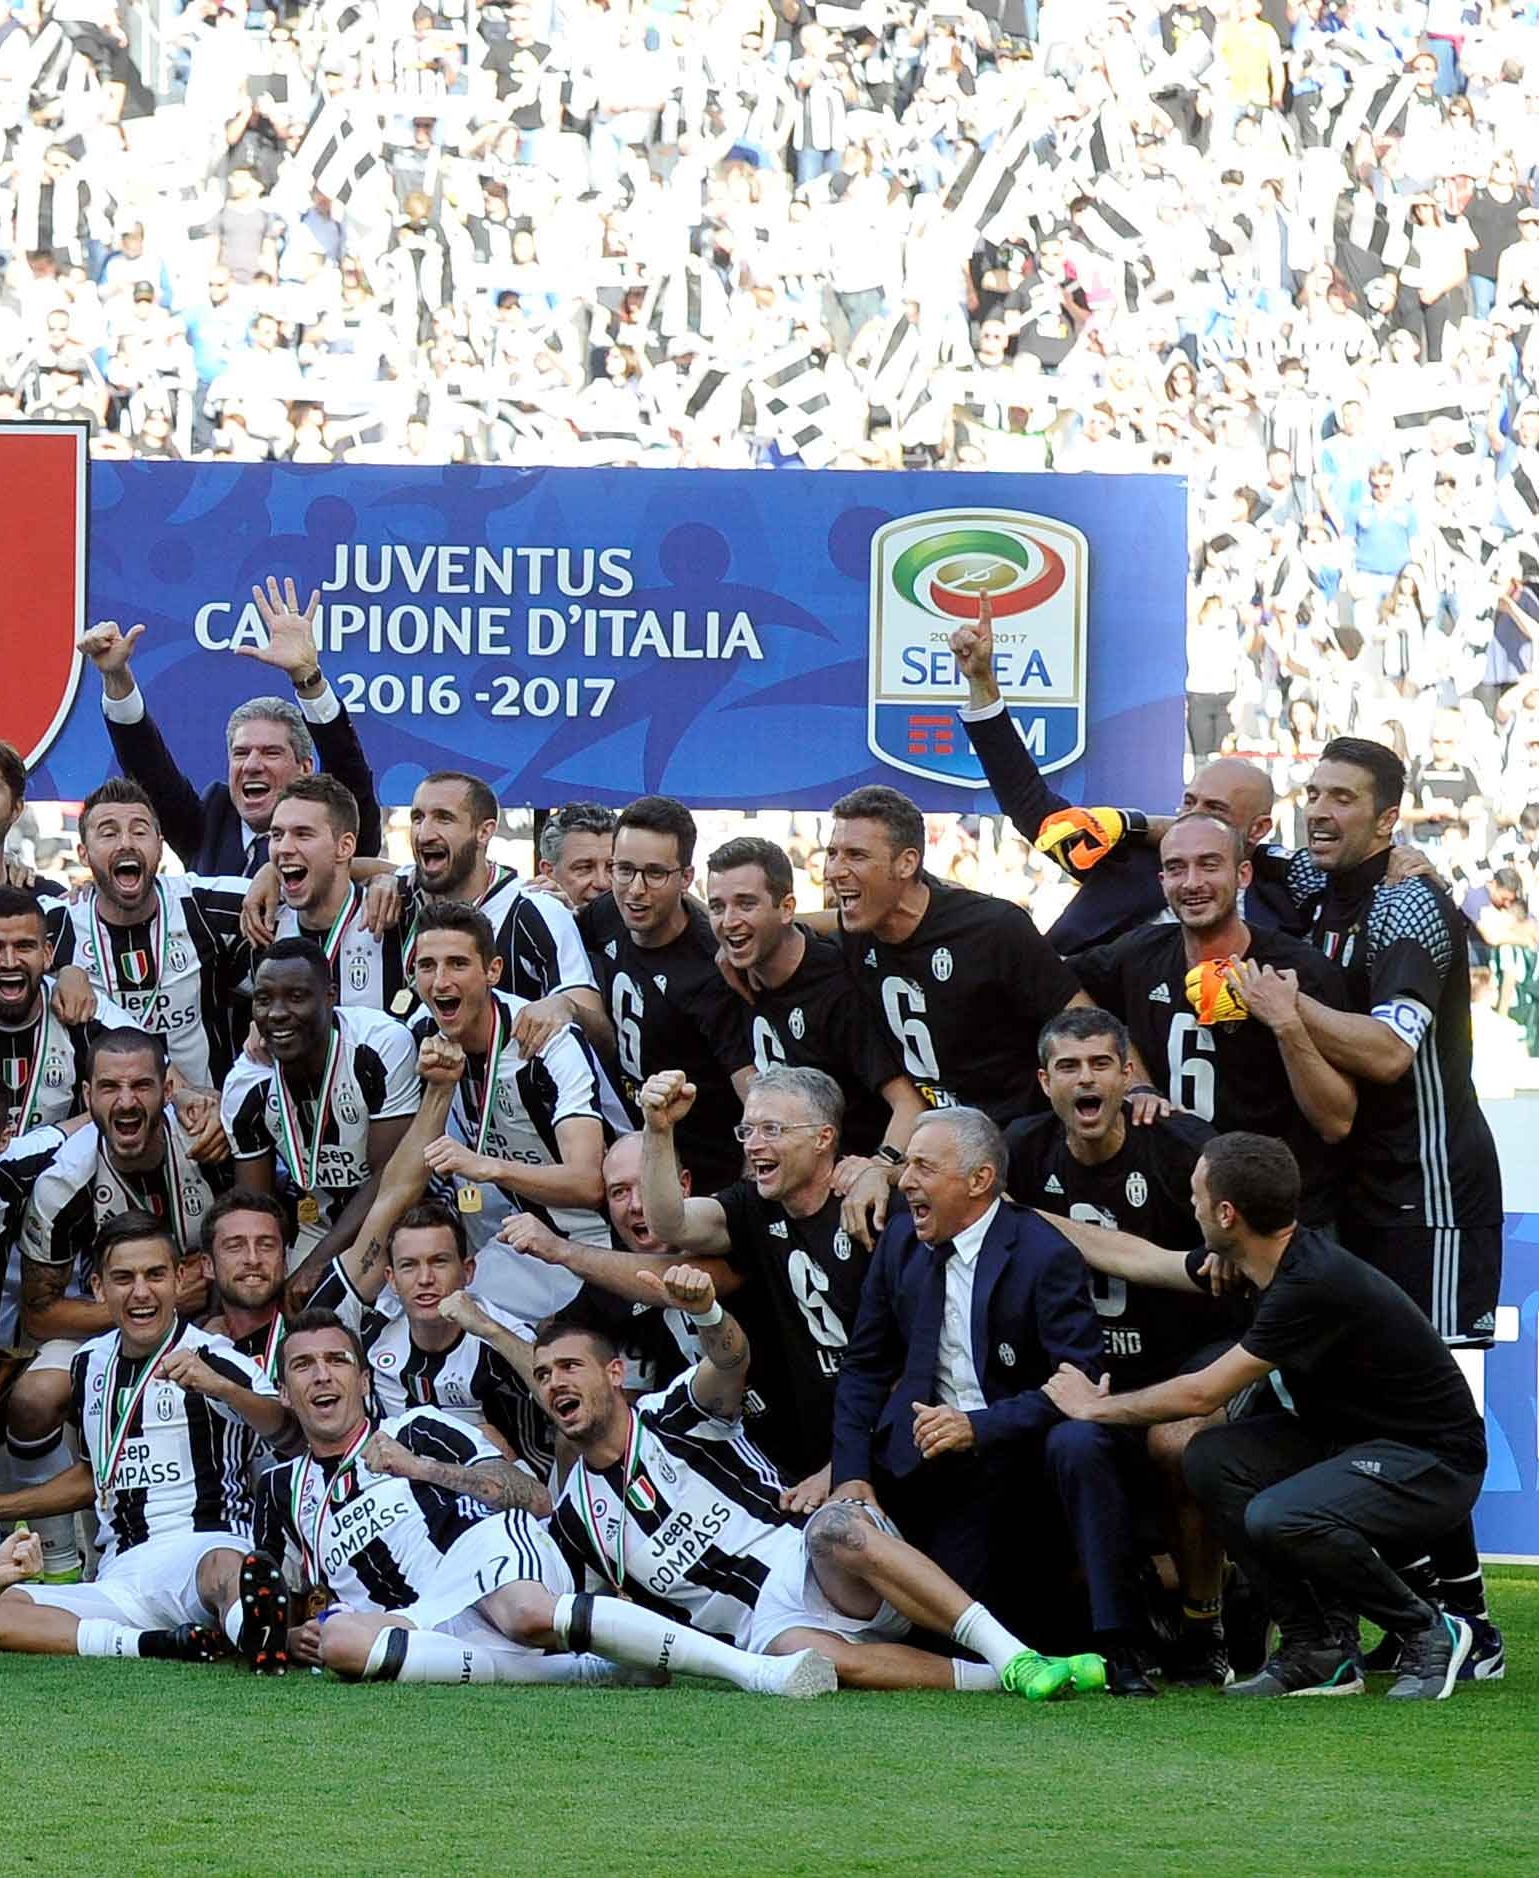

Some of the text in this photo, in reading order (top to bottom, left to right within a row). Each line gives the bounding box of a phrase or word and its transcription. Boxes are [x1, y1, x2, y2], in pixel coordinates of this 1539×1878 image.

[322, 544, 634, 597] JUVENTUS
[194, 602, 764, 659] CAPIONE D'ITALIA
[337, 674, 461, 715] 2016
[902, 646, 1053, 687] SEE A
[612, 972, 644, 1081] 6
[882, 976, 940, 1080] 6
[1168, 1012, 1216, 1122] 6
[788, 1249, 848, 1347] 6
[324, 1502, 410, 1576] COMPASS
[330, 1497, 376, 1538] Jeep
[652, 1511, 693, 1557] Jeep
[474, 1556, 510, 1594] 17
[648, 1502, 731, 1594] COMPASS
